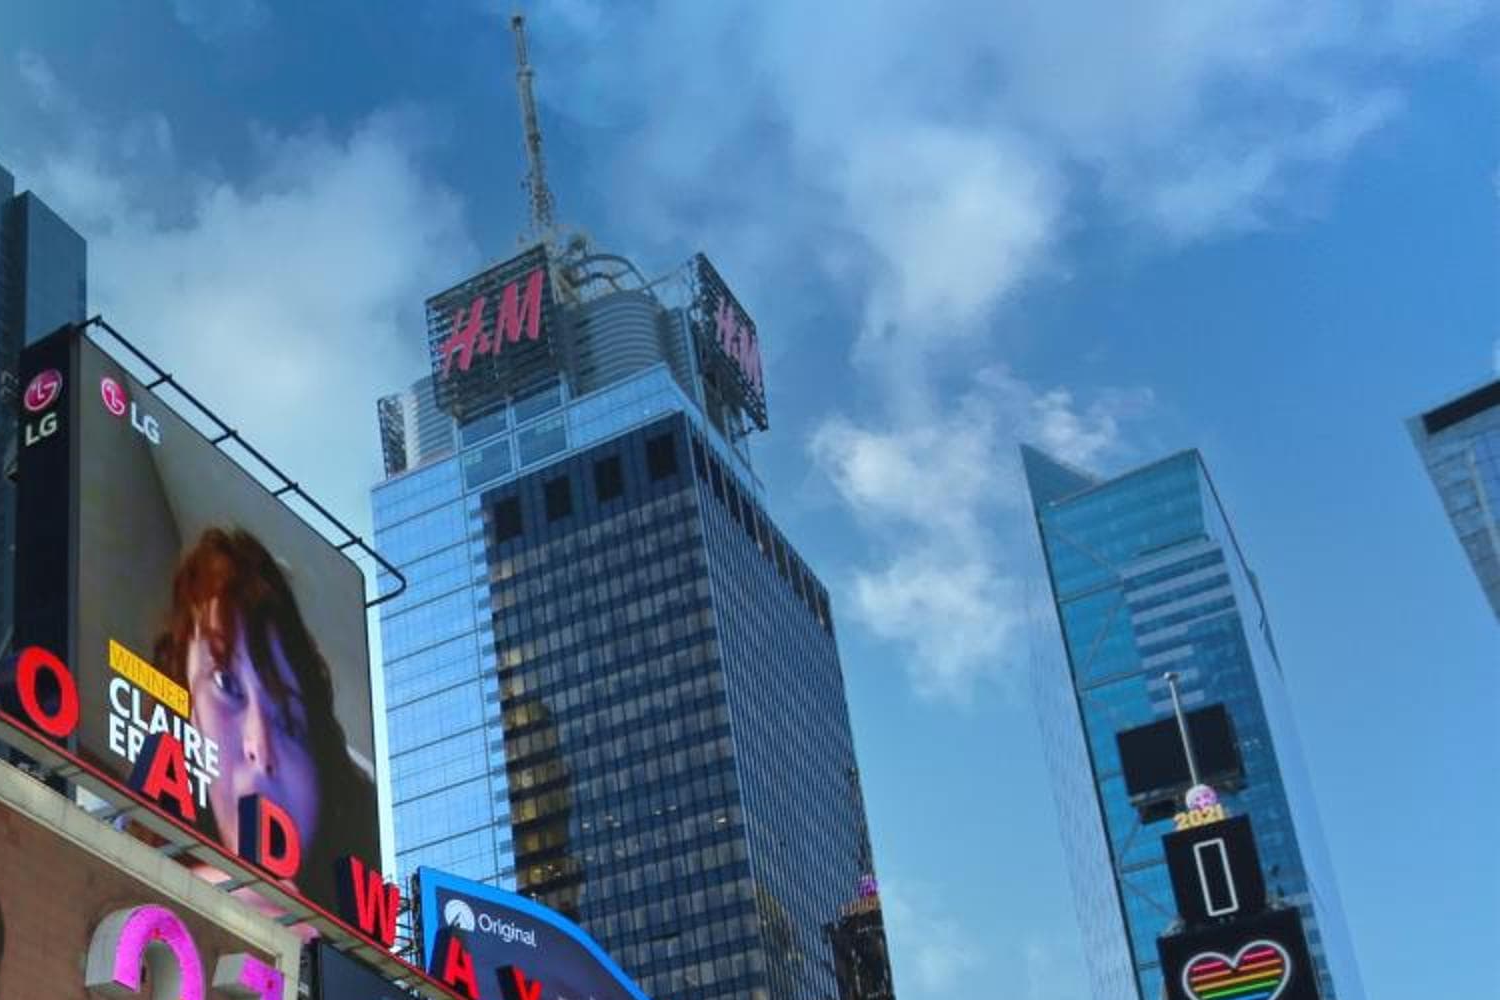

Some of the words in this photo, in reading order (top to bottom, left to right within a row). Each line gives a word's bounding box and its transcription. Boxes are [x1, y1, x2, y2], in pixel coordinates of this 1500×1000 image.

[438, 268, 546, 381] H&M
[25, 412, 57, 447] LG
[131, 401, 161, 446] LG
[109, 676, 220, 778] CLAIRE
[478, 912, 538, 949] Original
